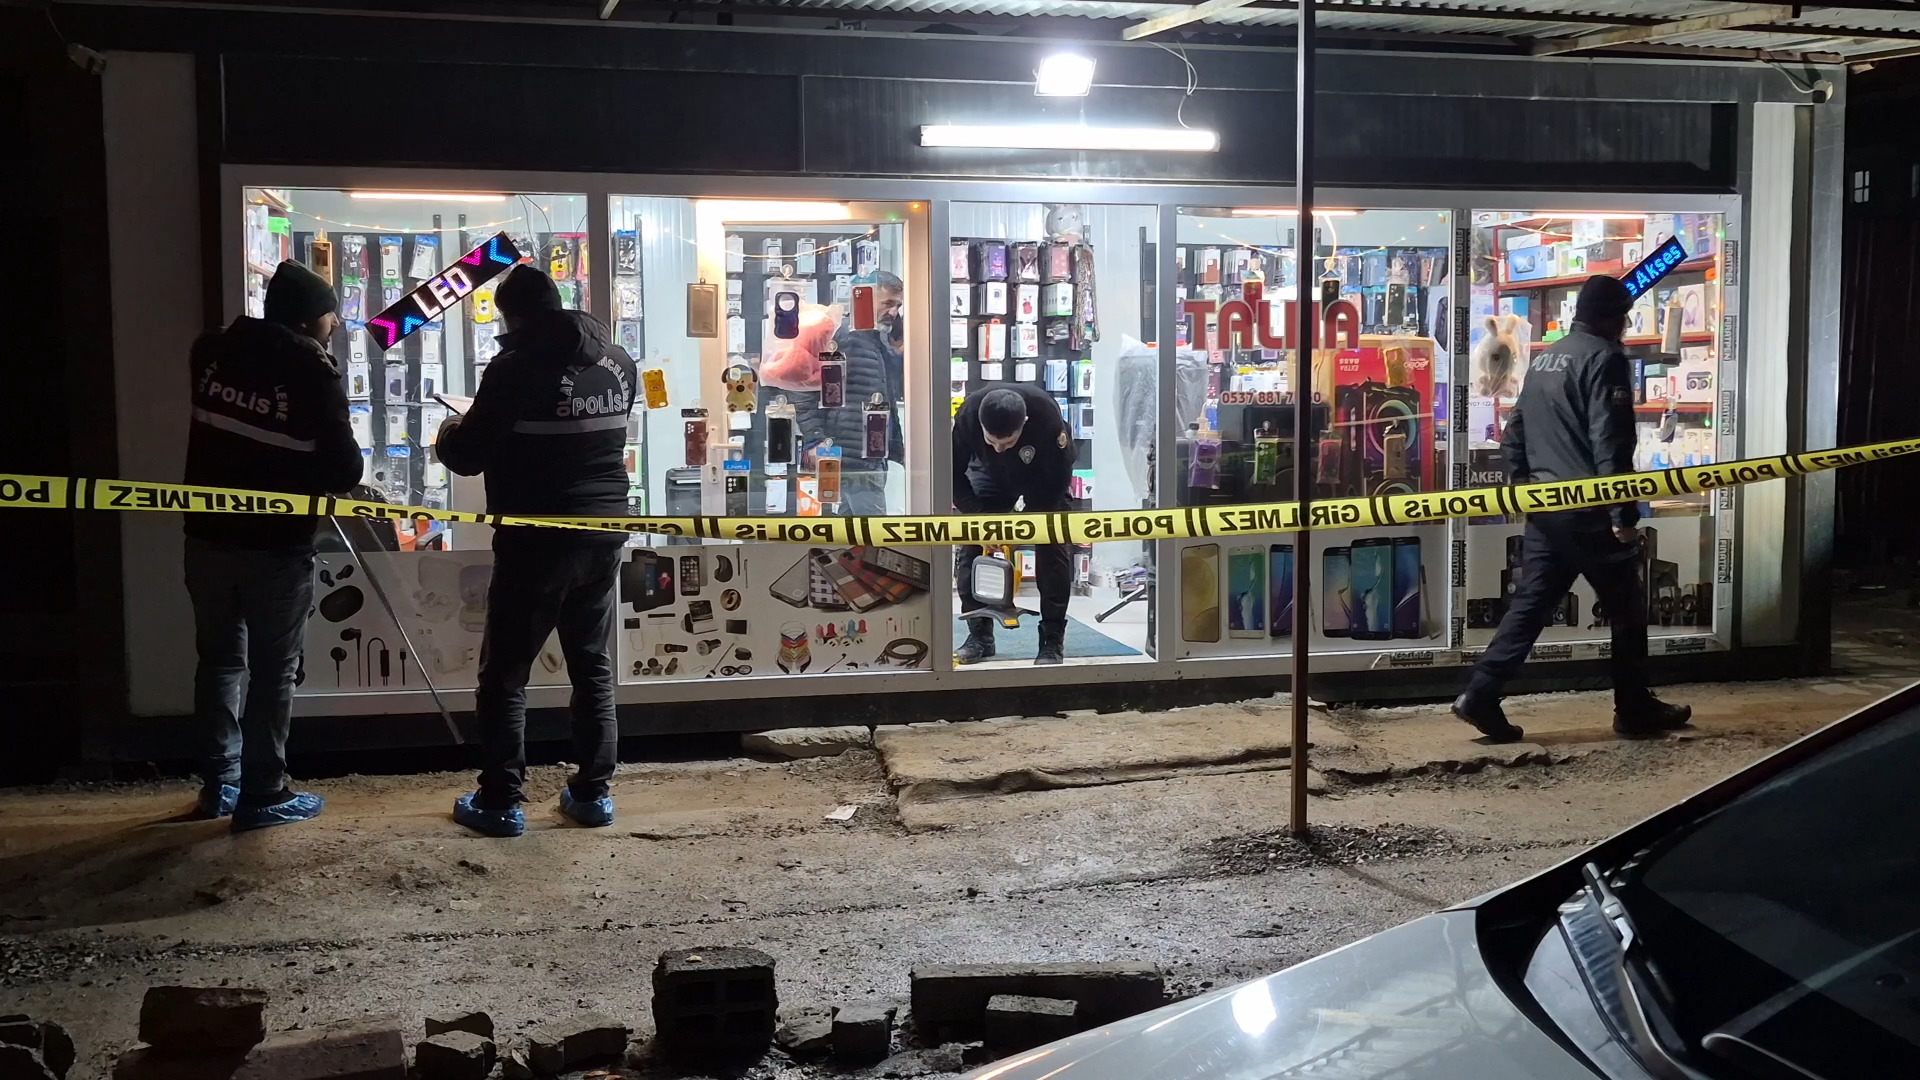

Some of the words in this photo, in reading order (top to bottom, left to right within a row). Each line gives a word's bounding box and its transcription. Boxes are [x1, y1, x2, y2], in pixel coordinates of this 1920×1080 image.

[1724, 241, 1734, 285] FIRATPEN
[412, 267, 473, 318] LED
[1722, 316, 1732, 361] FIRATPEN
[1222, 391, 1254, 405] 0537
[1257, 391, 1281, 404] 881
[1721, 391, 1731, 436] FIRATPEN
[1717, 540, 1727, 583] FIRATPEN
